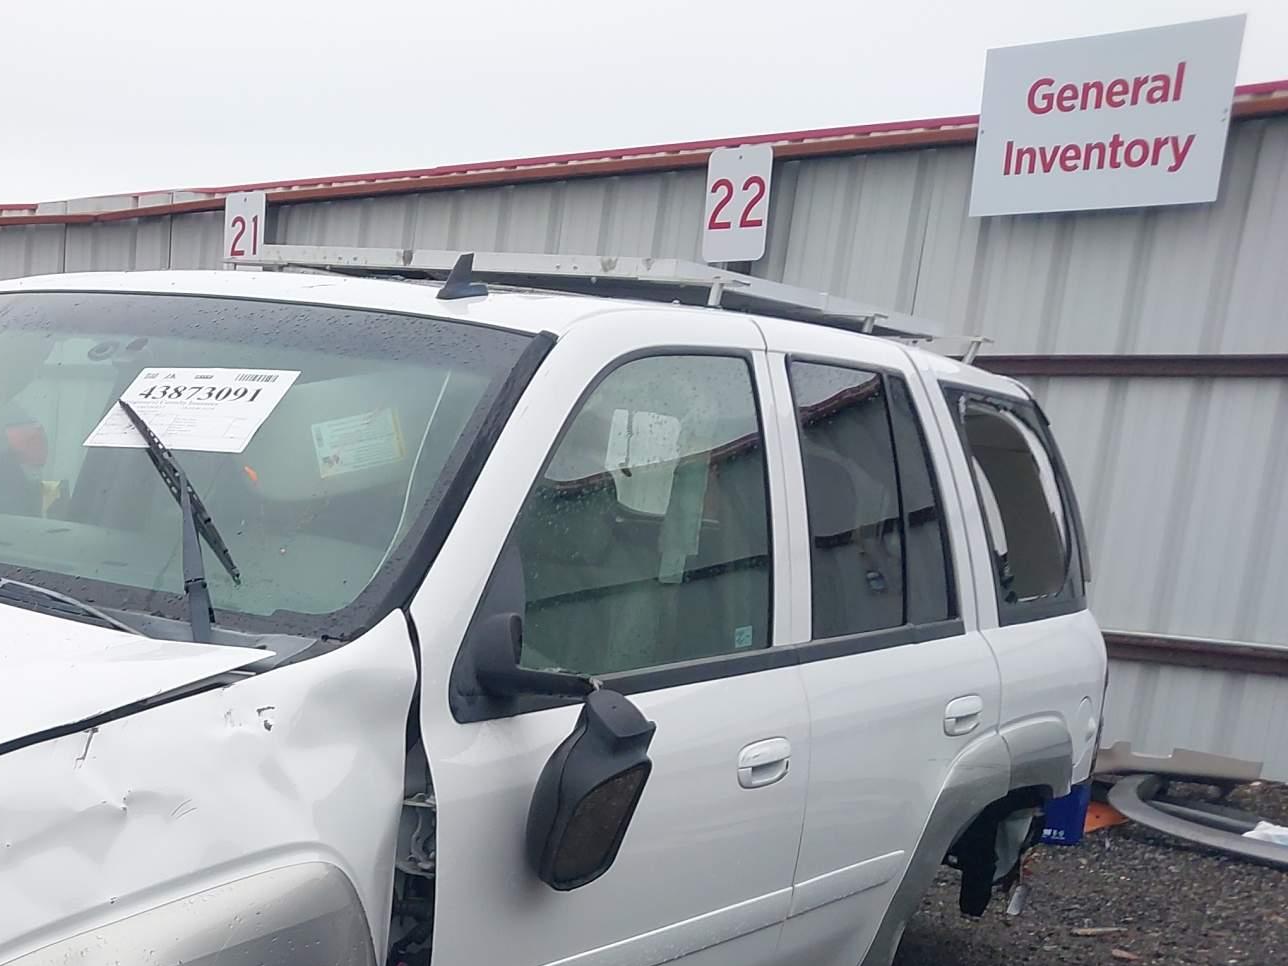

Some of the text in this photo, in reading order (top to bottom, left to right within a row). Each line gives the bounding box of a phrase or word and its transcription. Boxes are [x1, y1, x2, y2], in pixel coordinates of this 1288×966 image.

[1026, 61, 1187, 116] General
[1002, 133, 1197, 177] Inventory
[708, 175, 766, 230] 22
[230, 214, 259, 257] 21
[138, 385, 263, 402] 43873091
